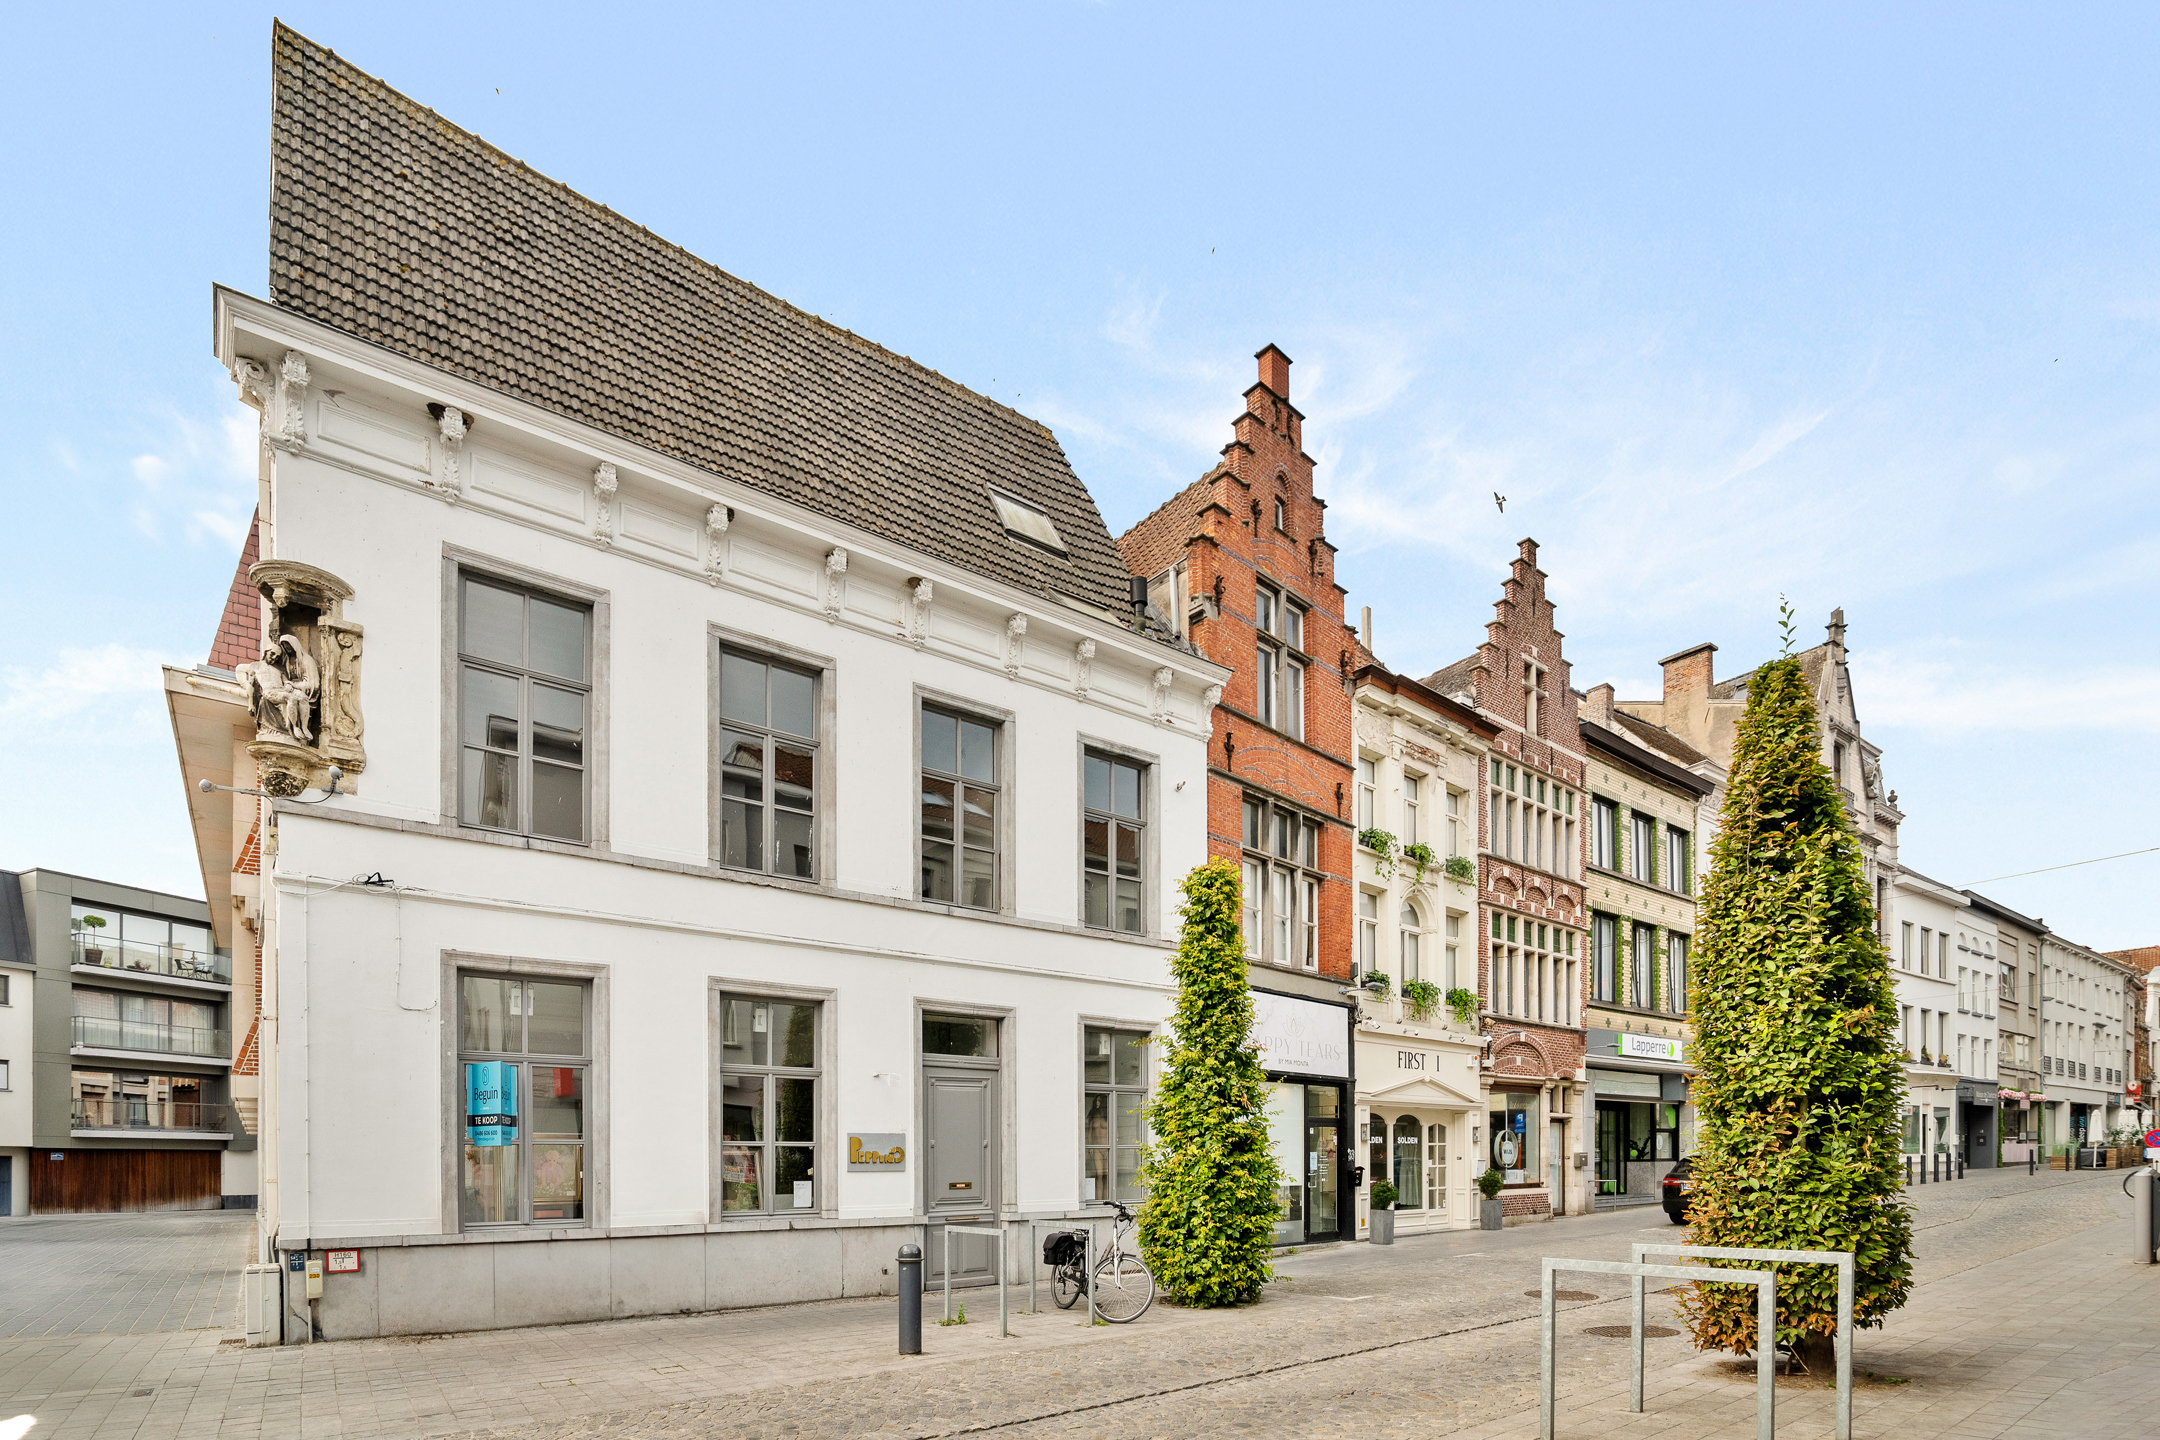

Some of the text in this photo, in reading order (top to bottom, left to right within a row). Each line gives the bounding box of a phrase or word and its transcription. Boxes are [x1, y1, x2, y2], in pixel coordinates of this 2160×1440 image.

[1299, 1040, 1341, 1061] TEARS
[1631, 1036, 1667, 1056] Lapperre
[1397, 1050, 1426, 1071] FIRST
[474, 1086, 499, 1105] Beguin
[482, 1116, 498, 1124] KOOP
[1397, 1136, 1419, 1144] SOLDEN
